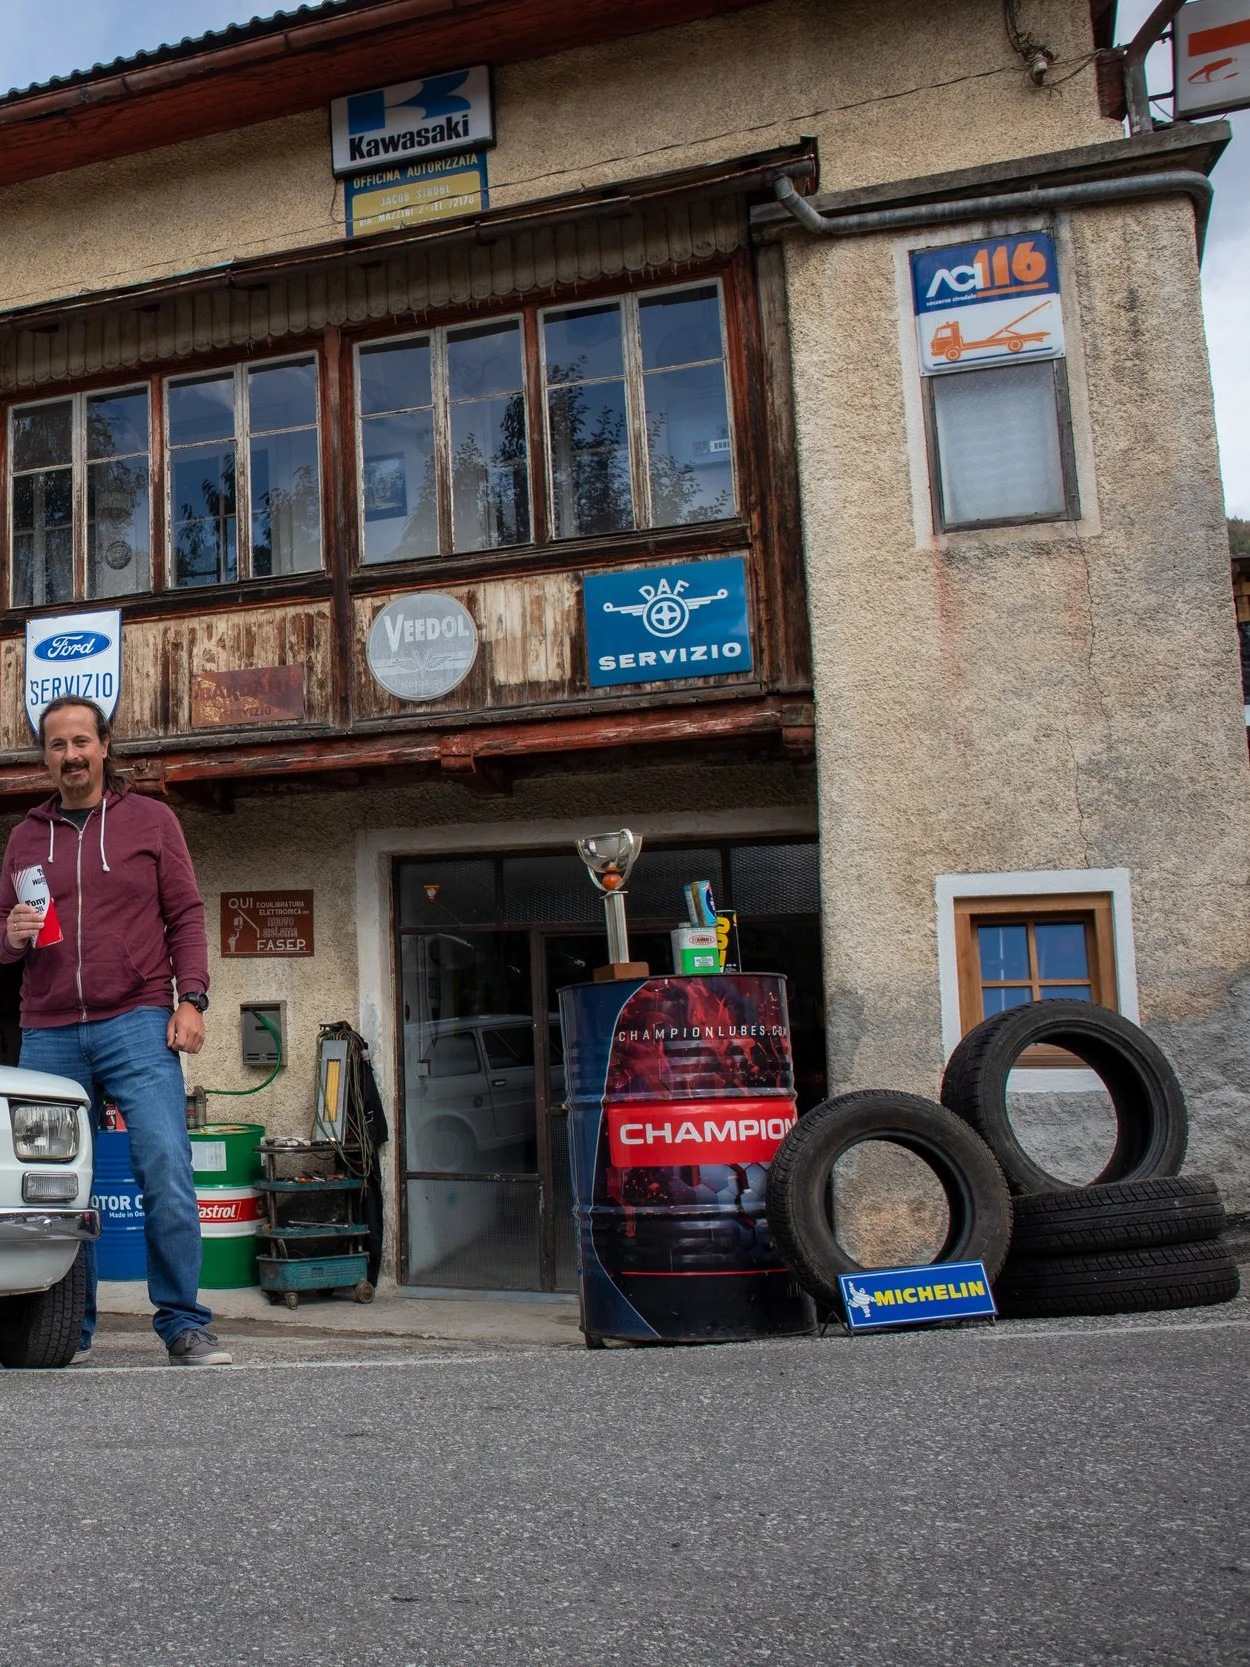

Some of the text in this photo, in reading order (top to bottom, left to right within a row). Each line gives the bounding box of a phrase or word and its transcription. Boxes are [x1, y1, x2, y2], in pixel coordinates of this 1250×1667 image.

[349, 113, 470, 161] Kawasaki
[353, 152, 478, 189] OFFICINA AUTORIZZATA
[926, 241, 1047, 298] ACI 116
[638, 578, 690, 601] DAF
[383, 613, 470, 652] VEEDOL
[47, 634, 96, 658] Ford
[598, 642, 742, 671] SERVIZIO
[30, 672, 113, 706] SERVIZIO
[25, 897, 46, 907] Tony
[228, 897, 253, 909] QUI
[256, 900, 305, 909] EQUILIBRATURA
[262, 926, 299, 938] sistema
[91, 1194, 132, 1211] OTOR
[197, 1204, 237, 1219] astrol
[874, 1281, 986, 1307] MICHELIN
